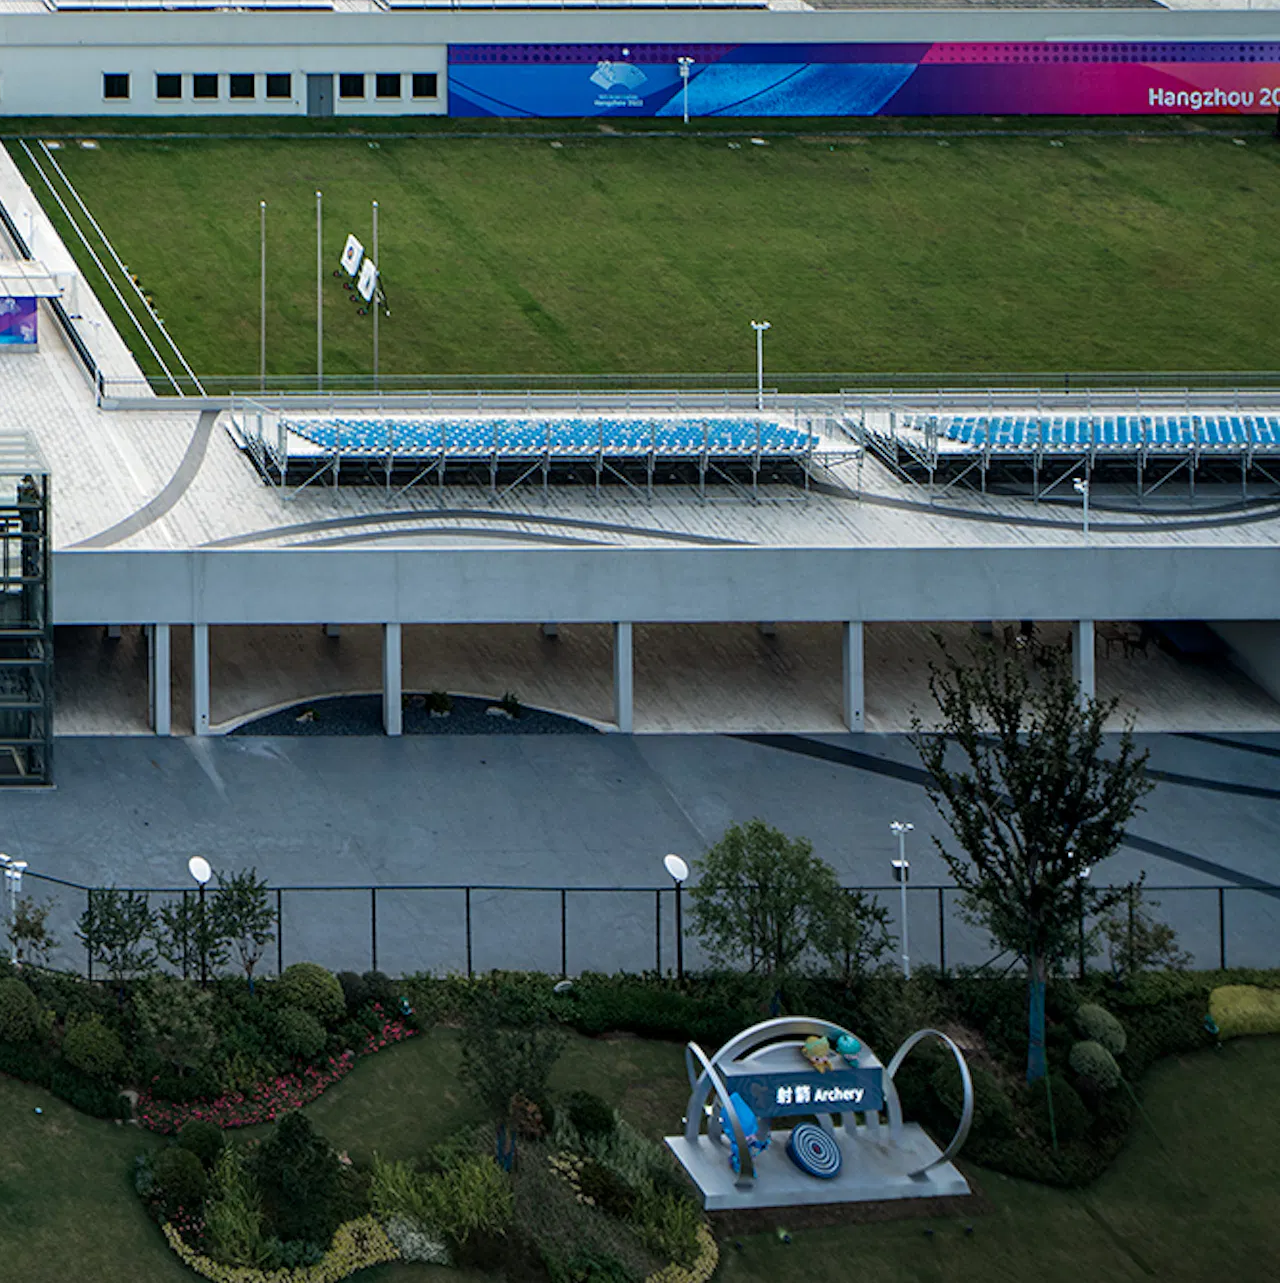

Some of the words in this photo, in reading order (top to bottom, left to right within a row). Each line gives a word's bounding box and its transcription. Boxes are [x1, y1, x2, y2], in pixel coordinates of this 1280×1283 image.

[1148, 87, 1255, 110] Hangzhou
[776, 1085, 811, 1104] 射箭
[814, 1085, 864, 1104] Archery
